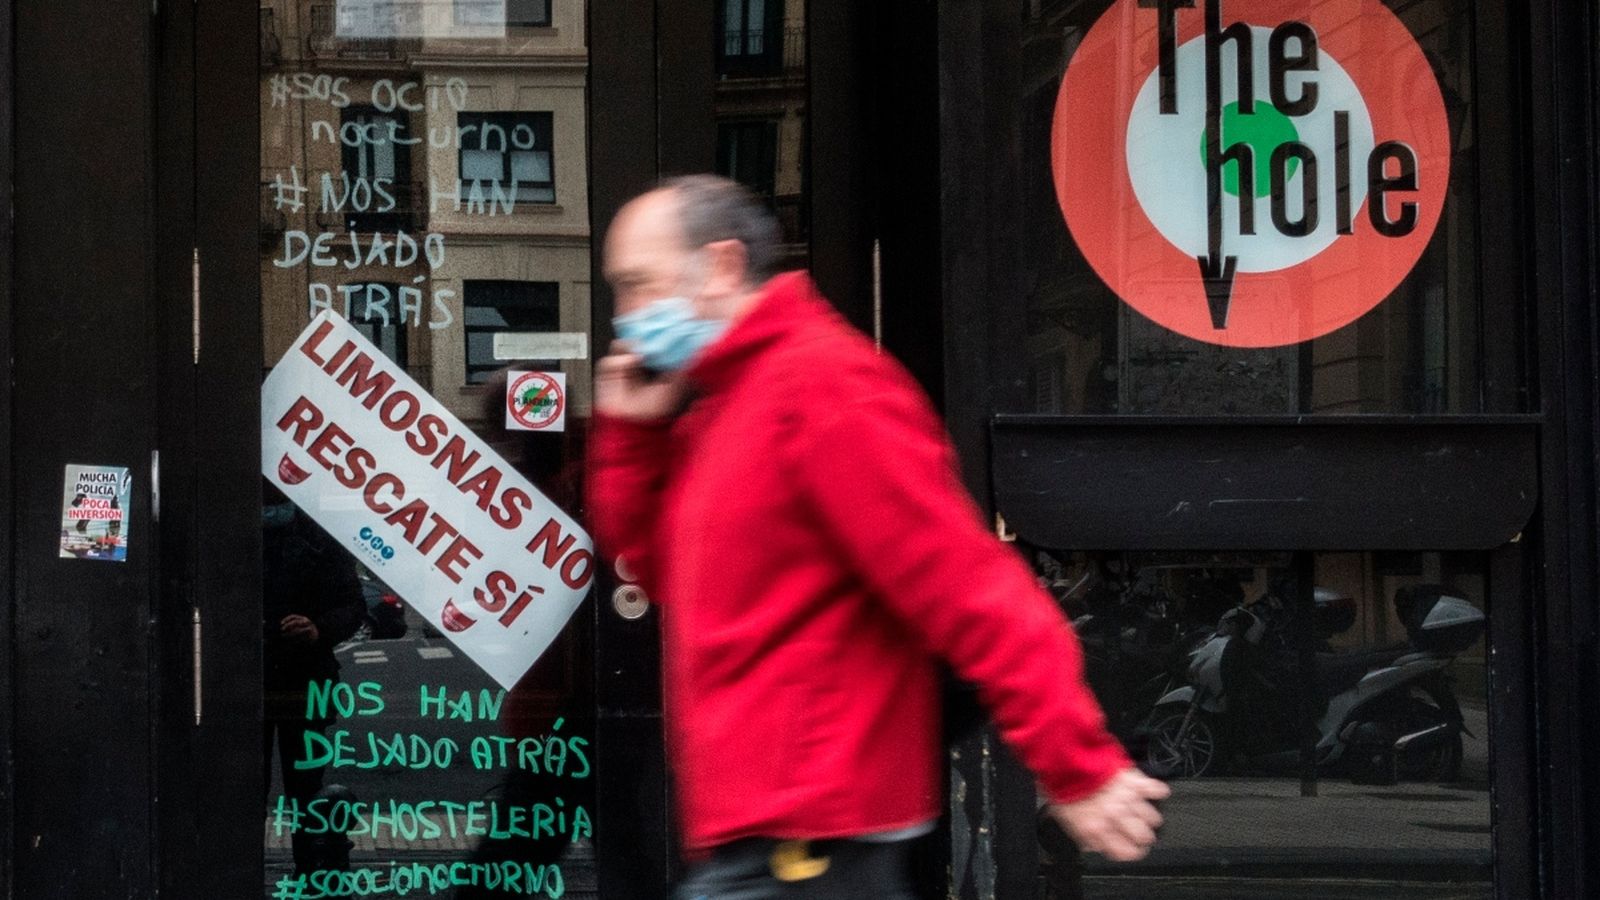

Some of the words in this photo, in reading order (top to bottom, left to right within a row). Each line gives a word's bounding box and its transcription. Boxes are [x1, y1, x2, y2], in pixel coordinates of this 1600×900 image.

[1137, 0, 1320, 117] The
[311, 120, 536, 154] nocturno
[429, 177, 518, 217] HAN
[1205, 110, 1420, 238] hole
[308, 275, 456, 330] ATRÁS
[79, 472, 117, 483] MUCHA
[299, 319, 533, 530] LIMOSNAS
[525, 517, 594, 591] NO
[83, 498, 110, 509] POCA
[276, 395, 484, 585] RESCATE
[472, 569, 546, 629] SÍ
[305, 679, 385, 720] NOS
[420, 684, 506, 722] HAN
[294, 729, 459, 769] DEJADO
[470, 717, 591, 778] ATRÁS
